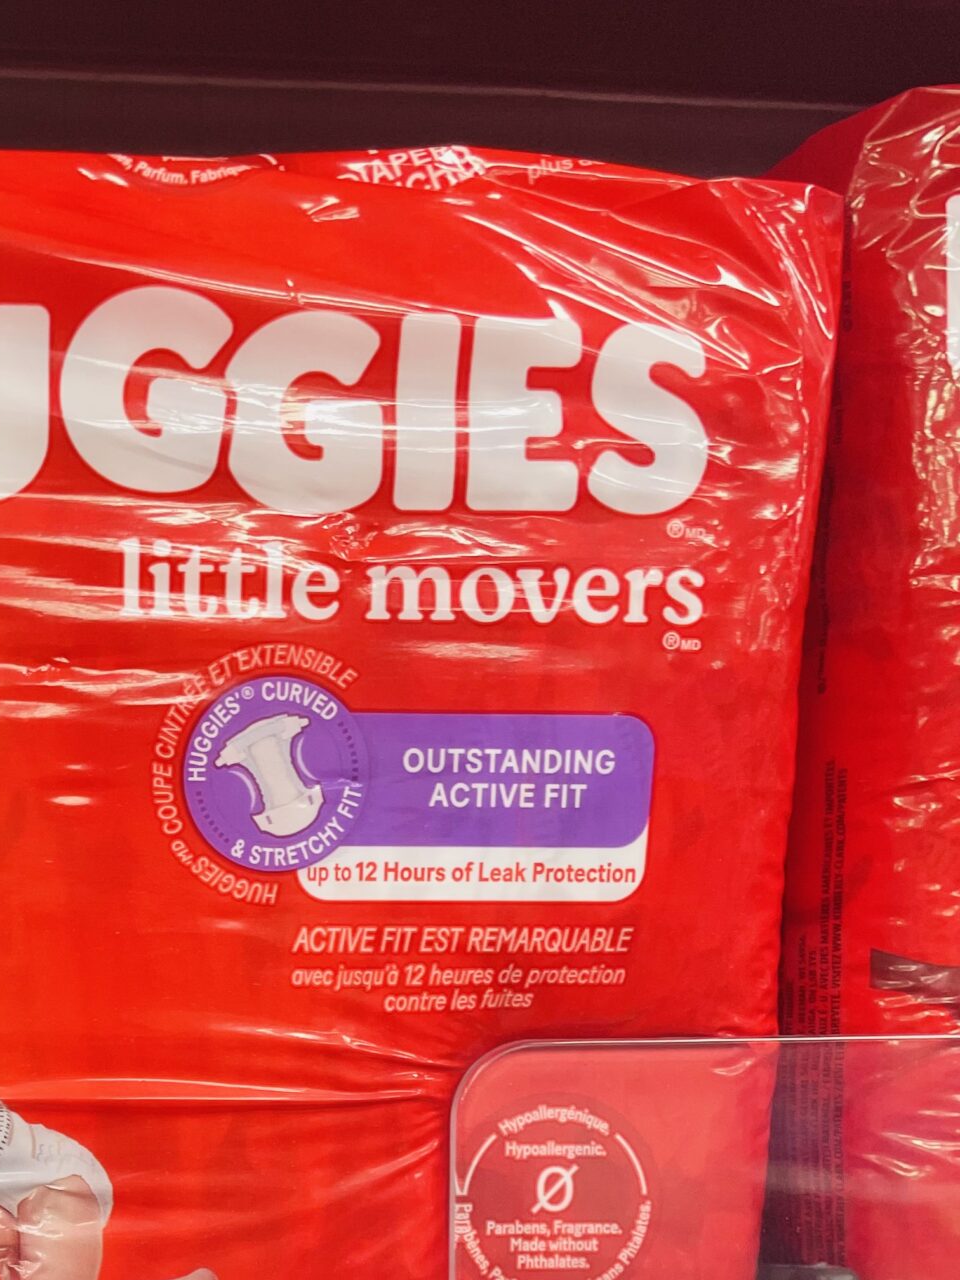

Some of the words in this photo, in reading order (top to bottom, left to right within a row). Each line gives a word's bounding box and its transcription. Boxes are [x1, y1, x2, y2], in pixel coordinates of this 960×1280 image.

[191, 165, 261, 185] Fabriq
[121, 537, 340, 621] little
[364, 564, 704, 625] movers
[261, 681, 338, 720] CURVED
[153, 761, 183, 835] COUPE
[208, 657, 234, 685] ET
[237, 643, 358, 689] EXTENSIBLE
[402, 748, 616, 776] OUTSTANDING
[428, 783, 536, 809] ACTIVE
[543, 783, 587, 809] FIT
[231, 839, 245, 858] &
[249, 818, 345, 866] STRETCHY
[337, 786, 362, 819] FIT
[307, 866, 329, 886] up
[334, 863, 352, 882] to
[355, 861, 378, 882] 12
[383, 862, 446, 883] Hours
[451, 861, 473, 882] of
[477, 861, 526, 883] Leak
[531, 862, 637, 884] Protection
[291, 927, 377, 953] ACTIVE
[380, 927, 417, 953] FIT
[419, 927, 463, 952] EST
[467, 927, 633, 953] REMARQUABLE
[291, 966, 333, 987] avec
[334, 964, 398, 991] jusqu'à
[403, 964, 423, 986] 12
[429, 963, 493, 986] heures
[497, 963, 523, 985] de
[524, 964, 626, 989] protection
[384, 991, 446, 1012] contre
[450, 989, 476, 1010] les
[479, 988, 534, 1010] fuites
[505, 1141, 607, 1160] Hypoallergenic.
[486, 1220, 551, 1236] Parabens,
[553, 1220, 622, 1237] Fragrance.
[619, 1200, 652, 1265] Phtalates.
[510, 1237, 546, 1251] Made
[549, 1237, 598, 1251] without
[517, 1254, 590, 1269] Phthalates.
